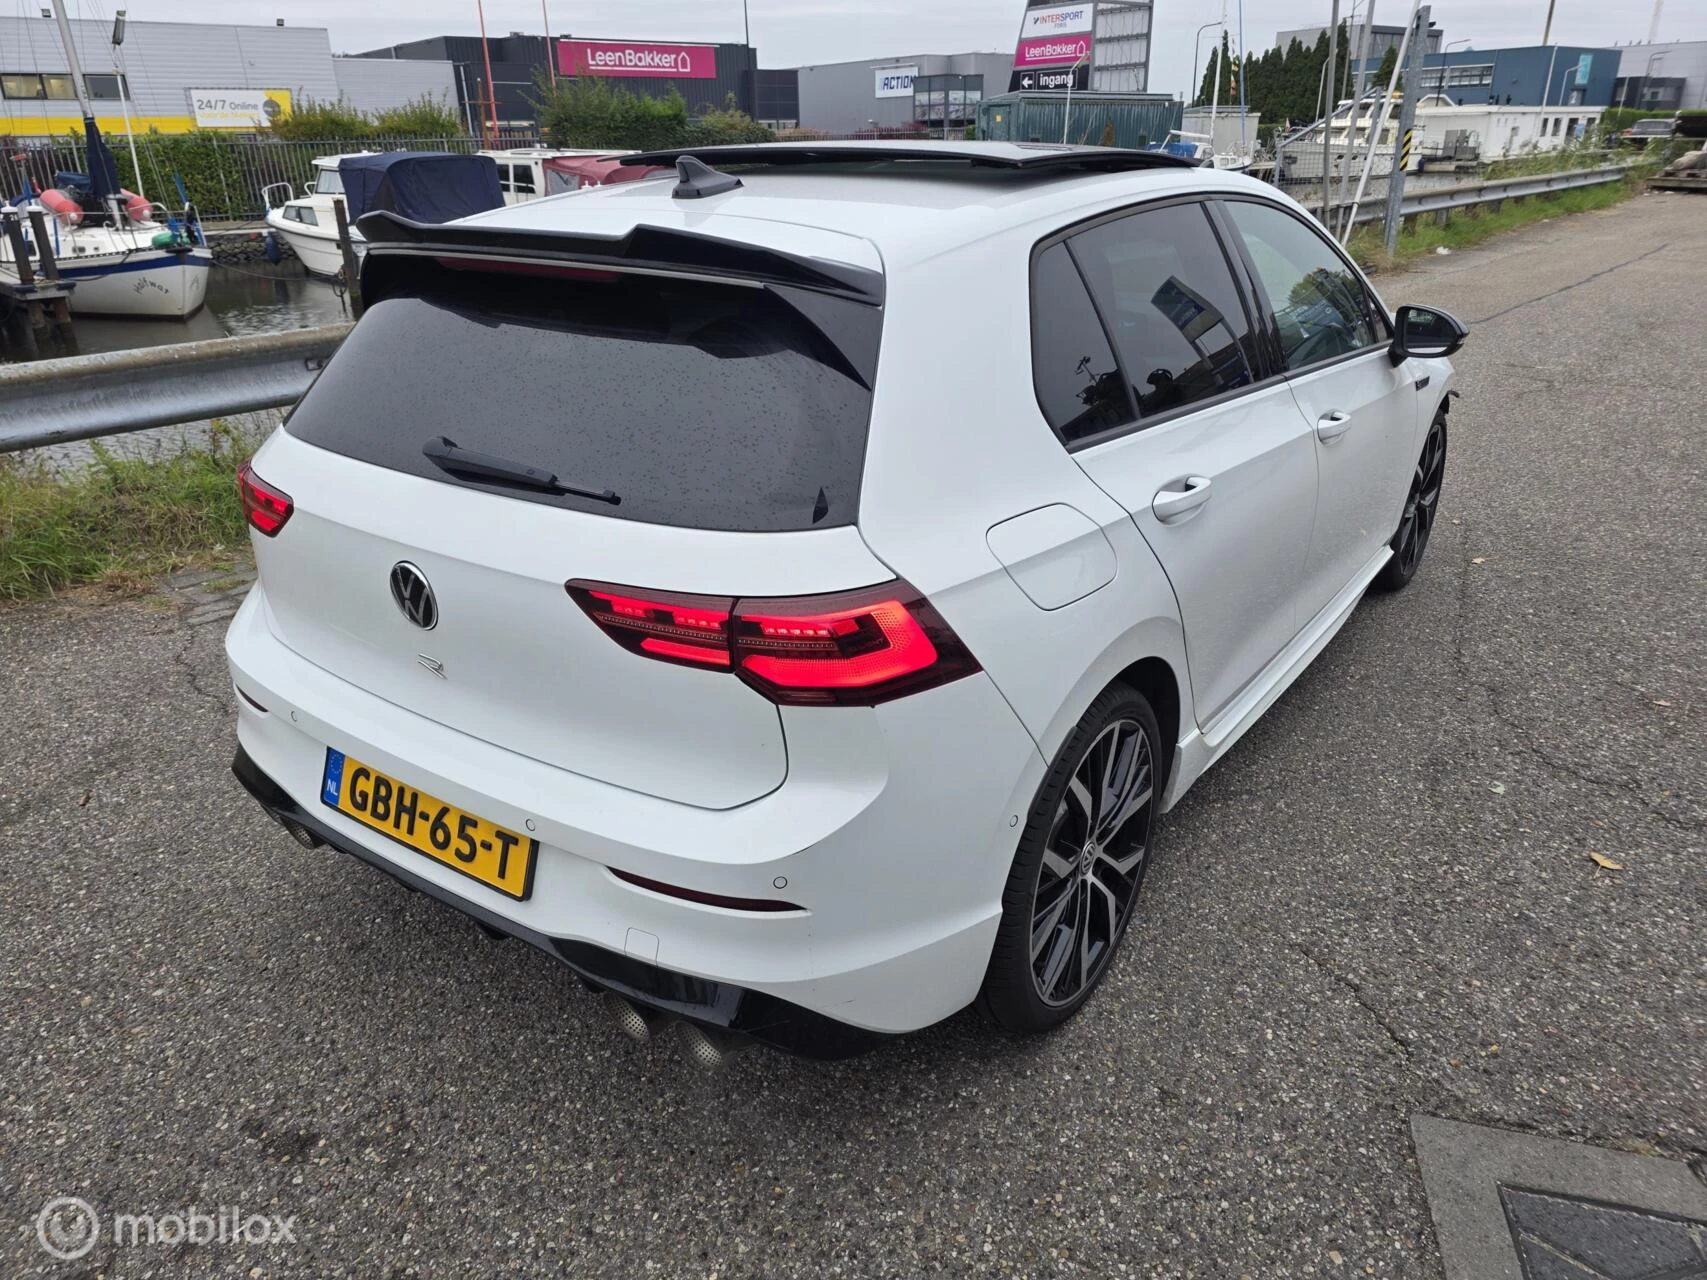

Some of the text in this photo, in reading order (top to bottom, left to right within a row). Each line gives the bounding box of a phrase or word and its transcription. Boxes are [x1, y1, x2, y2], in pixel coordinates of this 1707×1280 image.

[1039, 11, 1084, 24] INTERSPORT
[587, 48, 676, 66] LeenBakker
[1025, 44, 1076, 57] LeenBakker
[1039, 74, 1073, 88] ingang
[196, 99, 259, 111] 24/7 Online
[326, 778, 338, 797] NL
[349, 767, 519, 880] GBH-65-T
